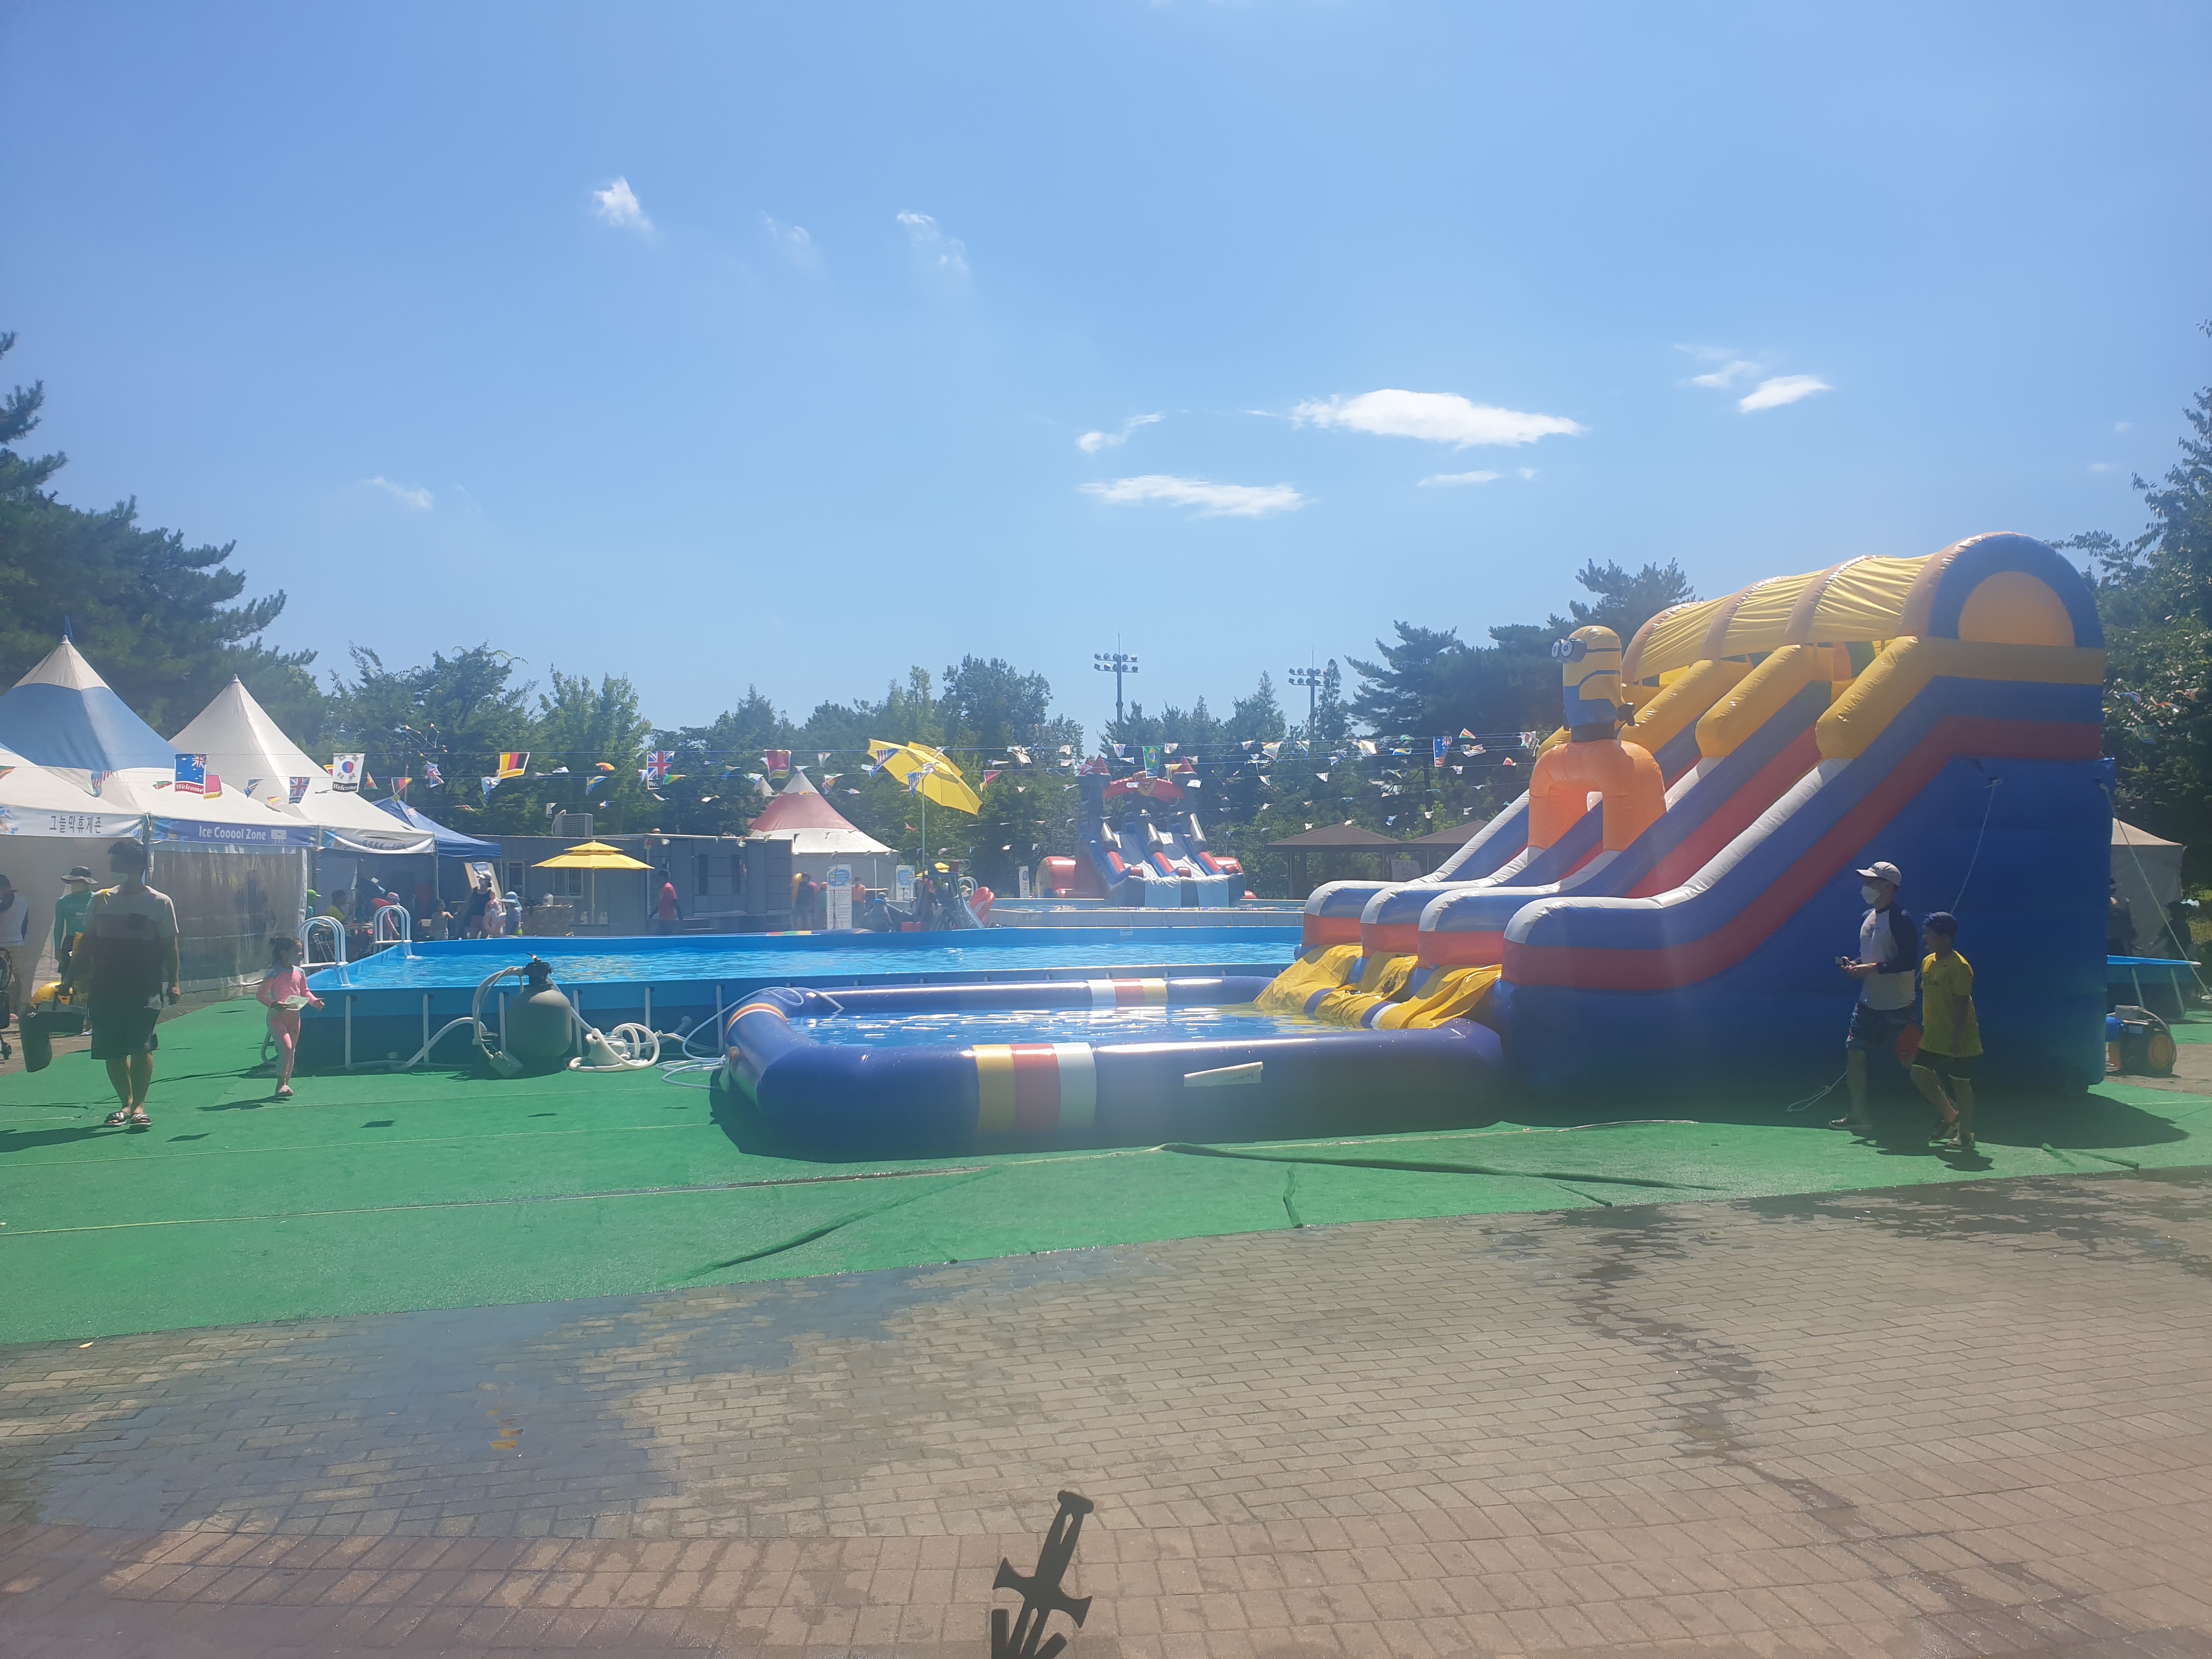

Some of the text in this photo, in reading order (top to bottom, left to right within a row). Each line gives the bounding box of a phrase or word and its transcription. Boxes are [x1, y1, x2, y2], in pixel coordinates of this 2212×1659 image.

[176, 783, 204, 793] Welcome
[49, 815, 101, 834] 그늘막휴게존
[199, 825, 267, 840] Ice Cooool Zone
